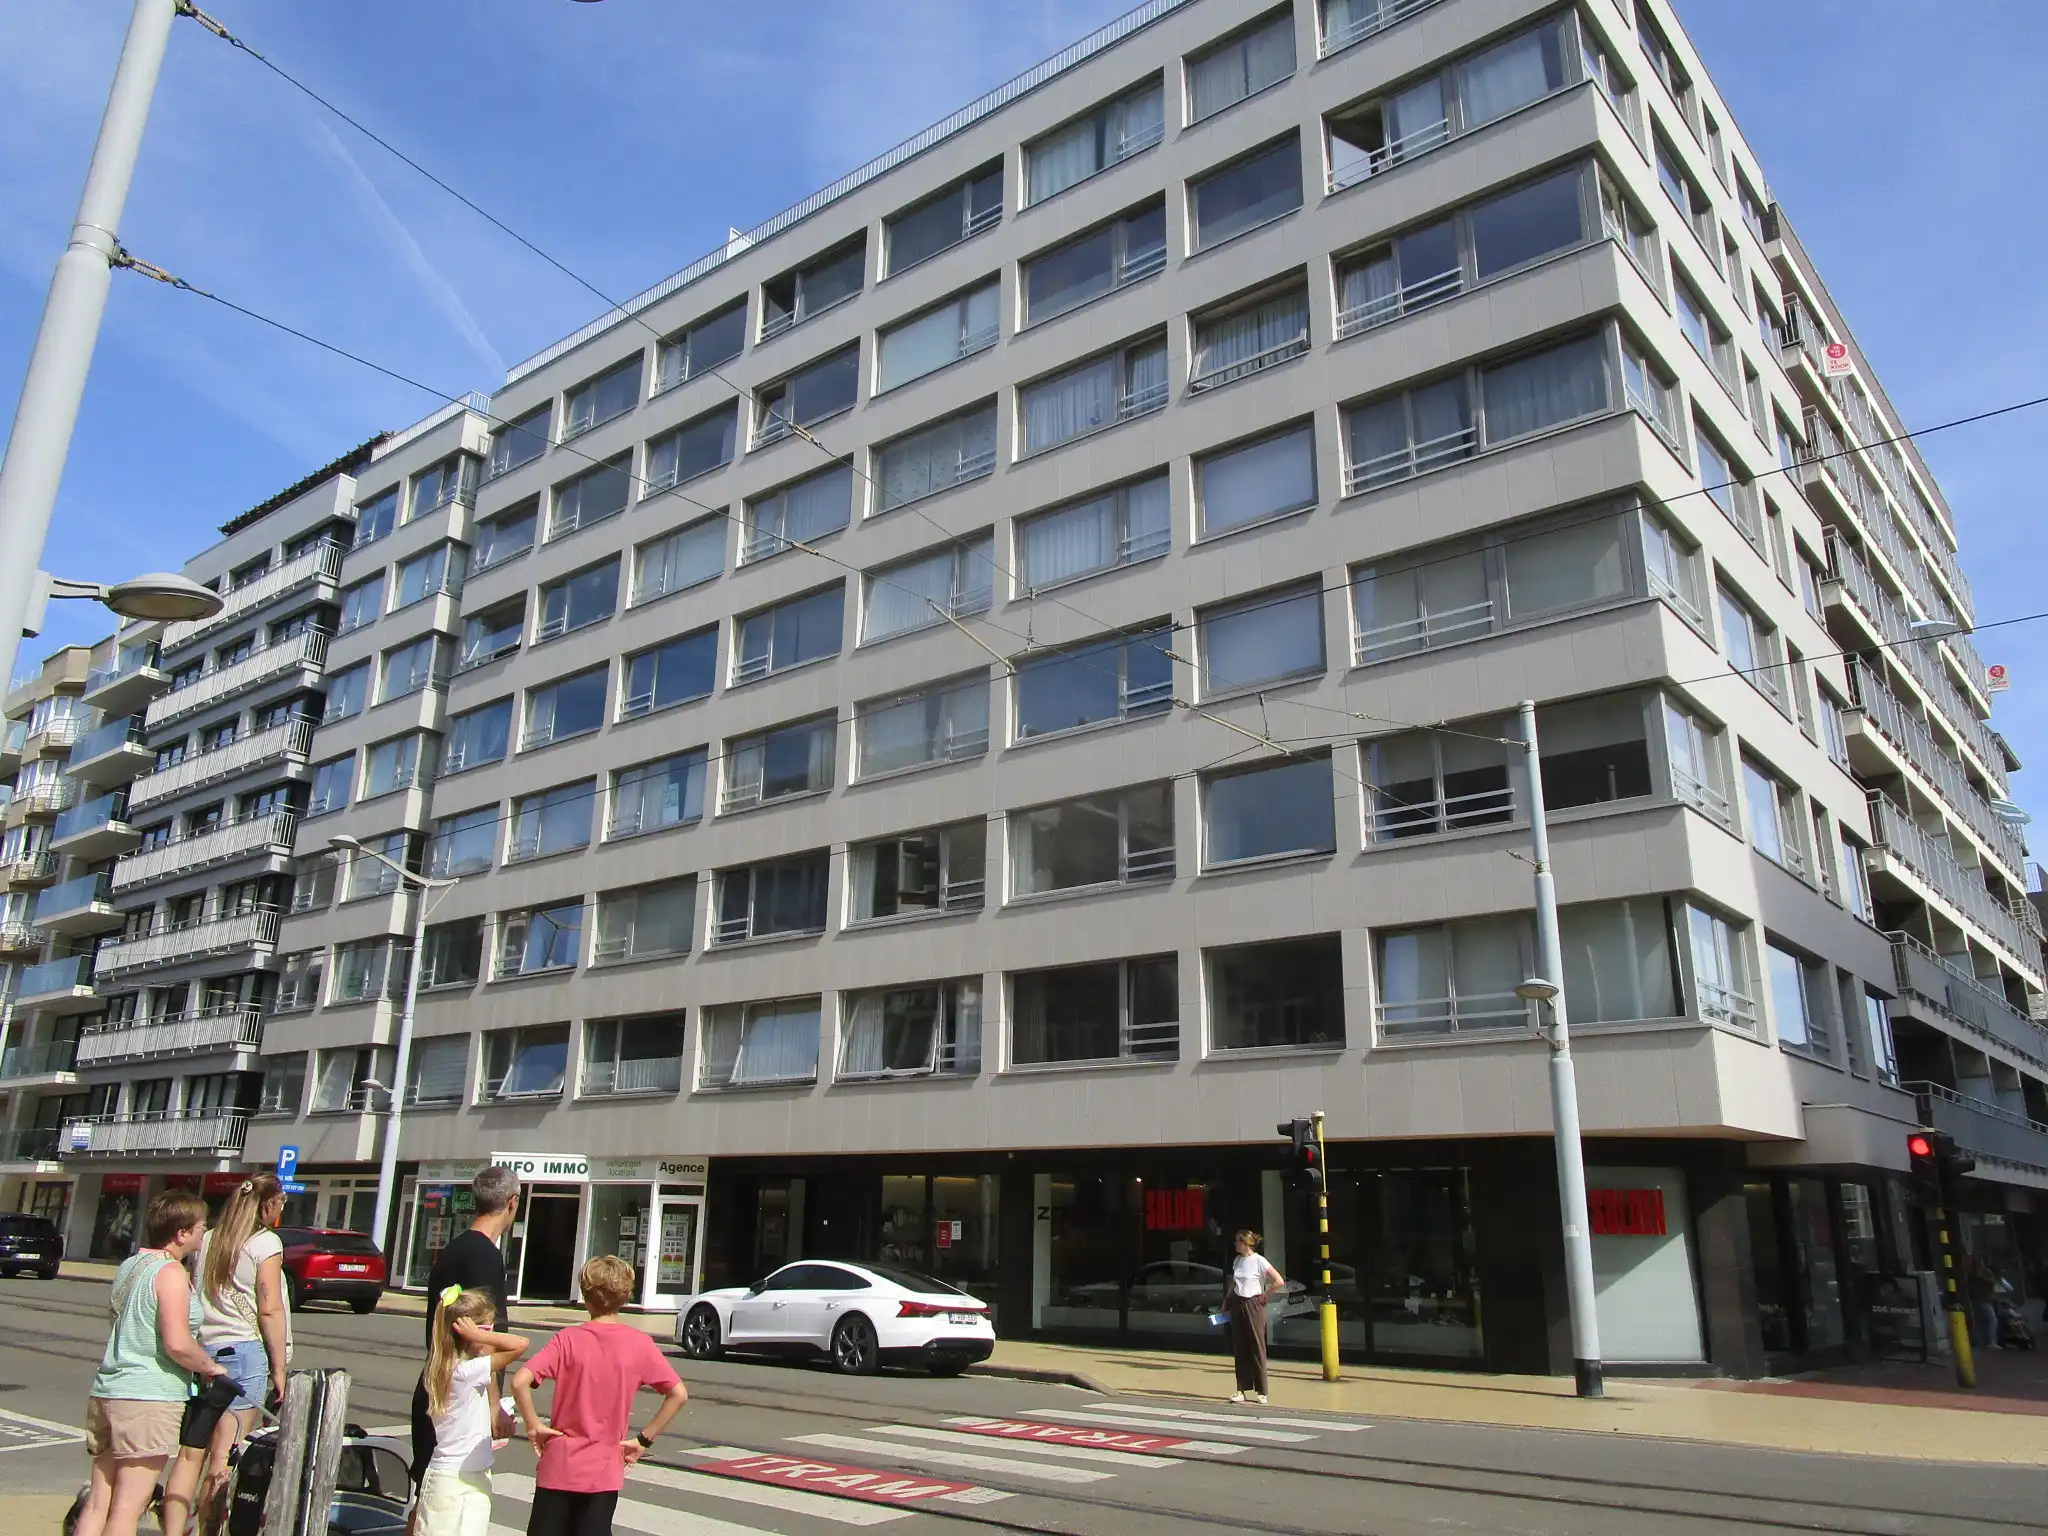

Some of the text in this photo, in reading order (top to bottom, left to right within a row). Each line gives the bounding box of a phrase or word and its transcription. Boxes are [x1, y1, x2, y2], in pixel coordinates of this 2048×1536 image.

[280, 1149, 296, 1169] P
[496, 1160, 535, 1174] INFO
[543, 1161, 588, 1174] IMMO
[659, 1162, 705, 1174] Agence
[971, 1422, 1161, 1449] TRAM
[732, 1457, 952, 1499] TRAM
